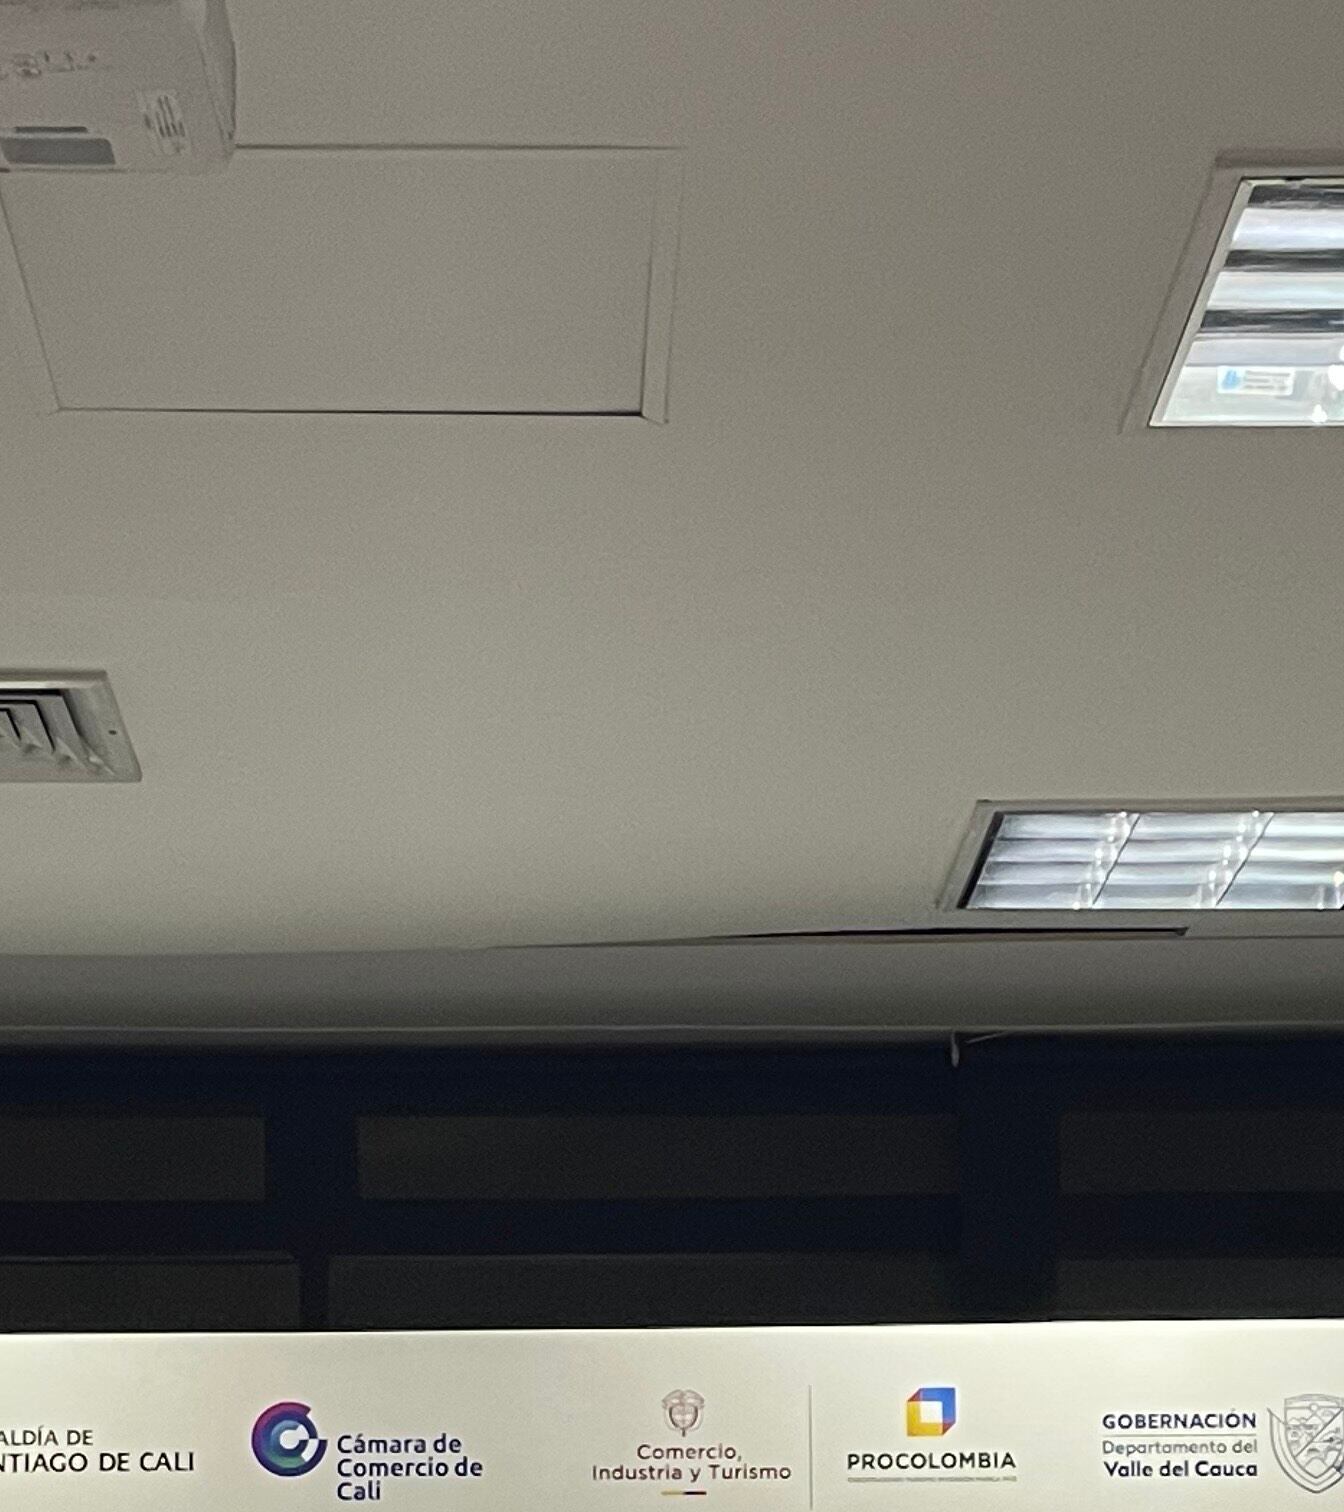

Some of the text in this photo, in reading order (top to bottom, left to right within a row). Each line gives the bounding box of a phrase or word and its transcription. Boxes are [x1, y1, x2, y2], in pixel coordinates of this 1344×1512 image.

[1102, 1407, 1257, 1430] GOBERNACIÓN
[66, 1429, 93, 1446] DE
[337, 1432, 462, 1454] Cámara de
[99, 1452, 130, 1472] DE
[139, 1451, 194, 1472] CALI
[636, 1443, 742, 1462] Comercio,
[847, 1452, 1017, 1470] PROCOLOMBIA
[337, 1458, 483, 1478] Comercio de
[592, 1463, 792, 1483] Industria y Turismo
[1103, 1460, 1258, 1478] Valle del Cauca
[336, 1480, 381, 1501] Cali
